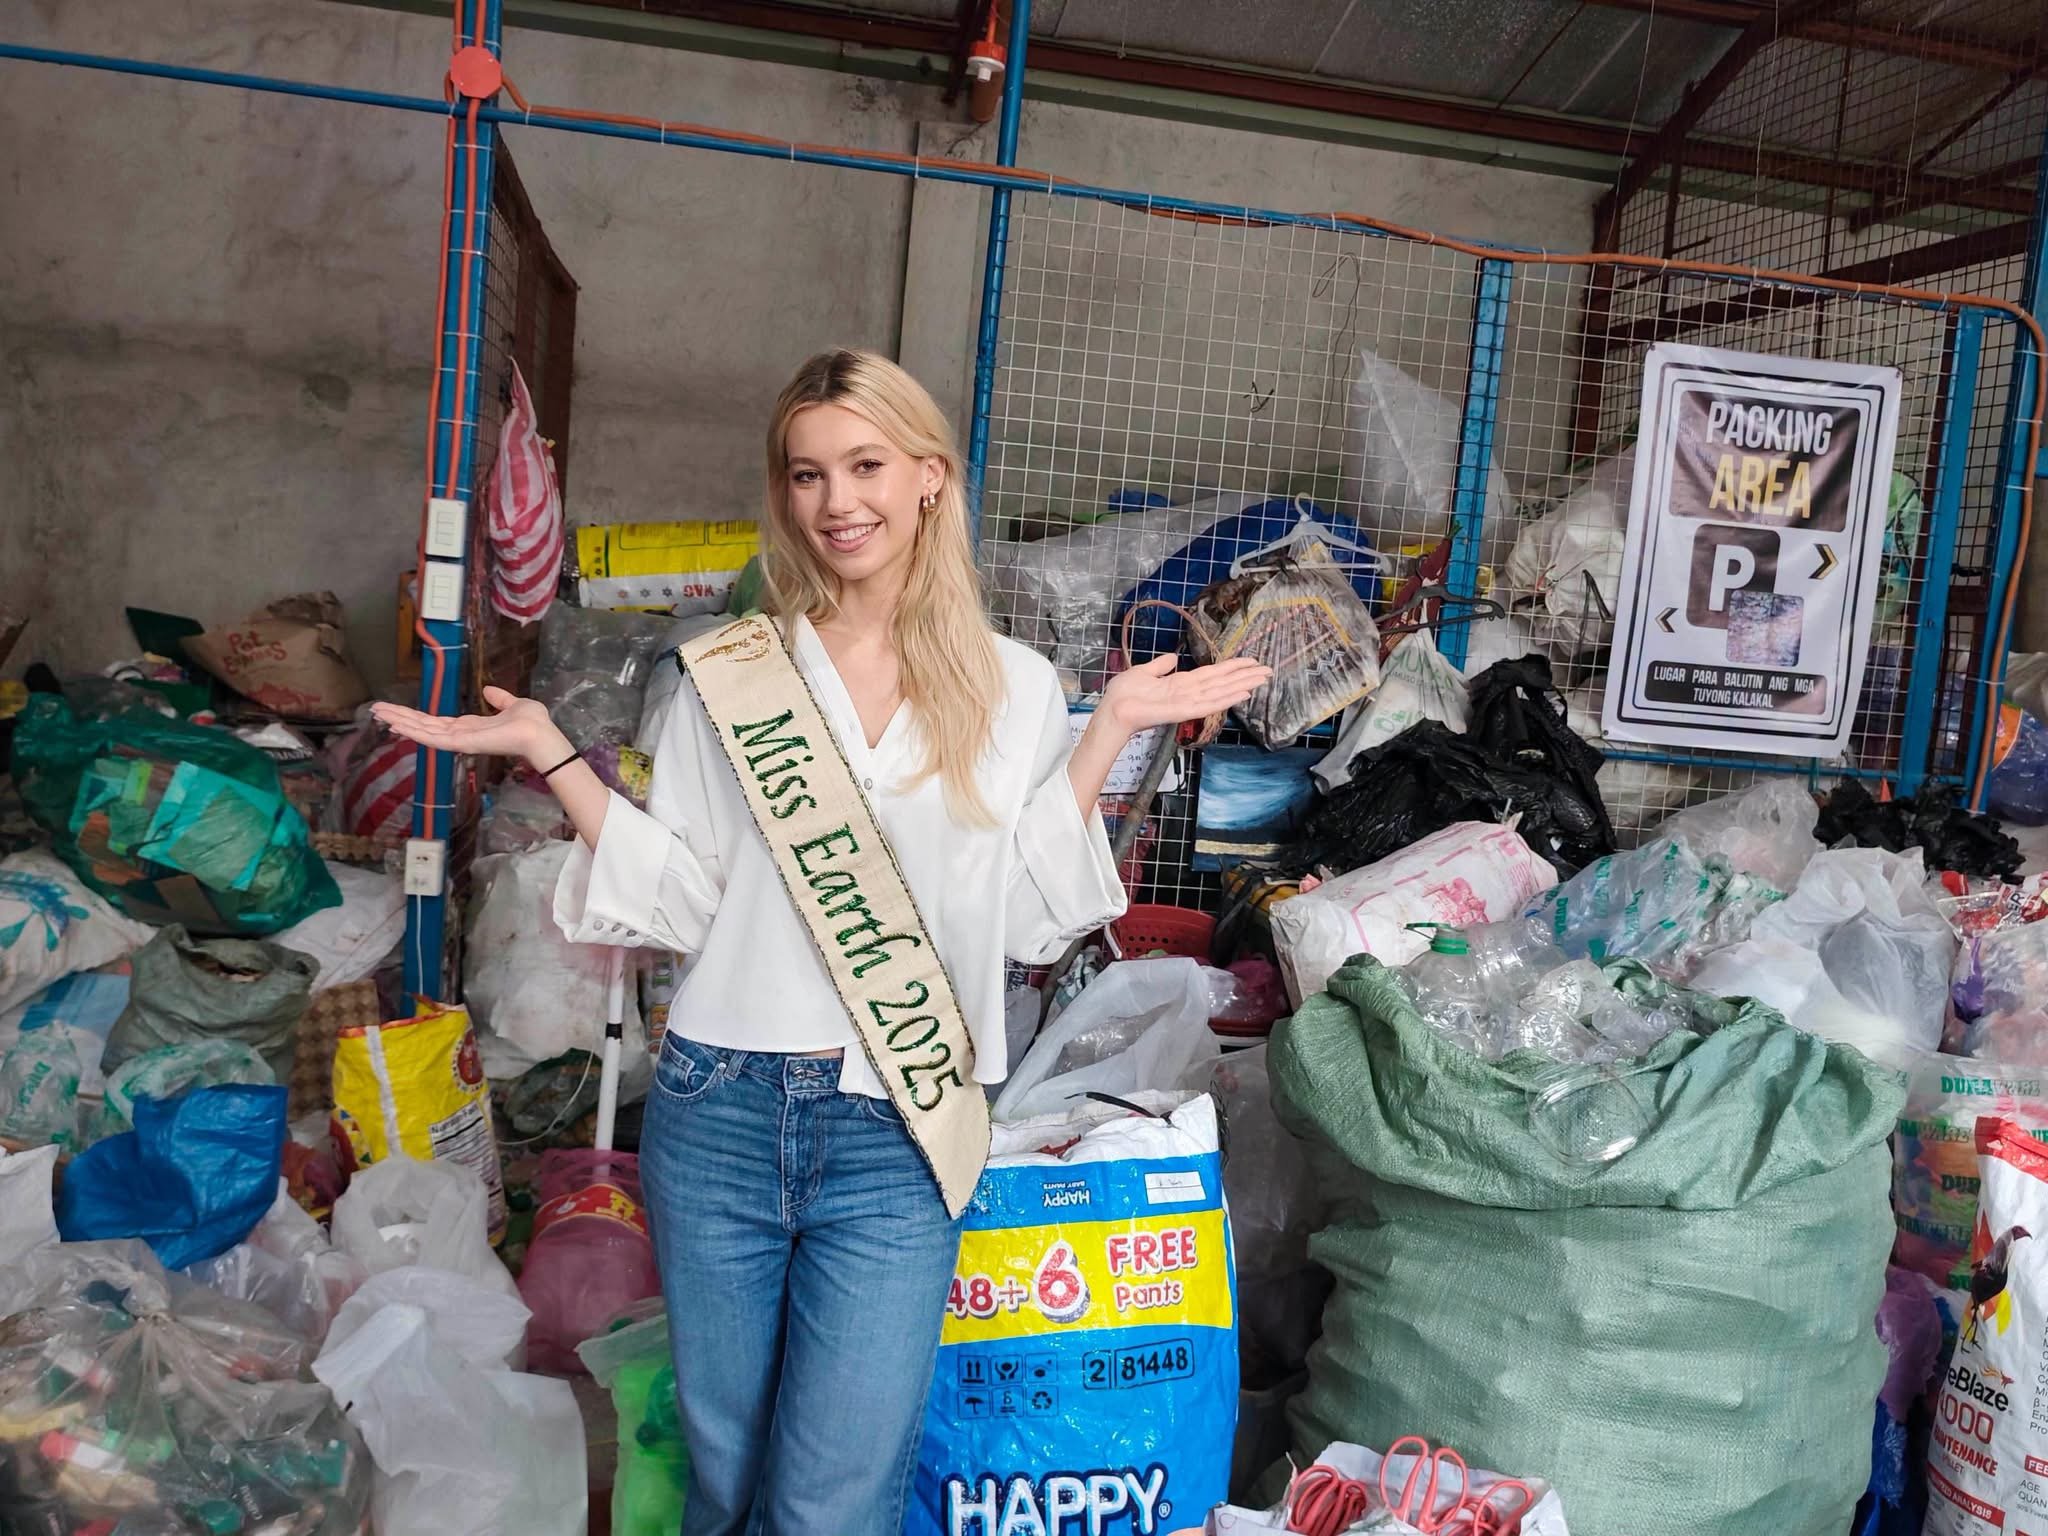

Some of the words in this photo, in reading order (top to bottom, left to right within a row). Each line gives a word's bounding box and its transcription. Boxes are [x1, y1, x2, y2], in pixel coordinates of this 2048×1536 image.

[1705, 401, 1834, 456] PACKING
[1708, 453, 1812, 520] AREA
[1709, 543, 1756, 612] P
[1653, 665, 1687, 682] LUGAR
[1691, 669, 1718, 686] PARA
[1723, 671, 1764, 690] BALUTIN
[1768, 676, 1789, 692] ANG
[1793, 678, 1815, 694] MGA
[1693, 687, 1732, 705] TUYONG
[1732, 690, 1774, 708] KALAKAL
[730, 708, 818, 820] Miss
[789, 821, 922, 979] Earth
[867, 980, 964, 1112] 2025
[1043, 1189, 1091, 1208] HAPPY
[1108, 1229, 1197, 1272] FREE
[1116, 1279, 1182, 1310] Pants
[1088, 1359, 1107, 1385] 2
[1121, 1347, 1189, 1381] 81448
